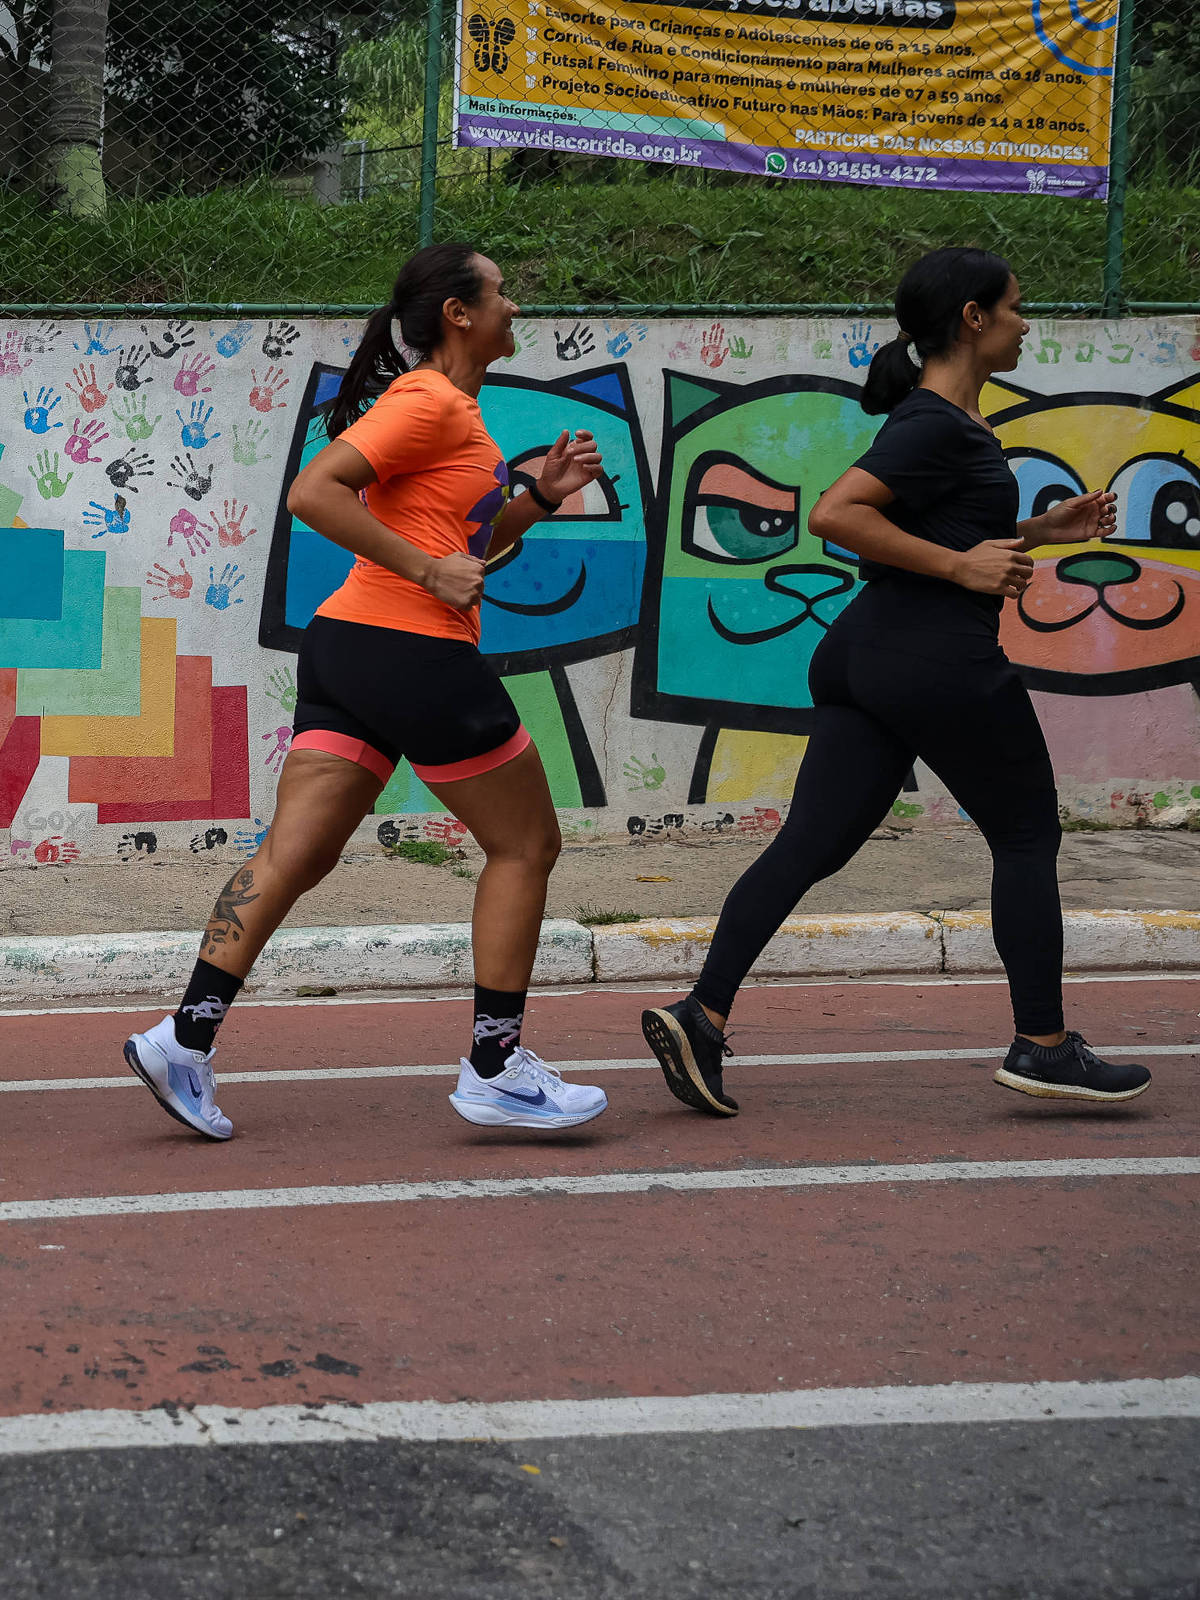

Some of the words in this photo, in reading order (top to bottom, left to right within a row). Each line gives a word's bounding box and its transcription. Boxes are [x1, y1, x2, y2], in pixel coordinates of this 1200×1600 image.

[545, 6, 605, 26] Esporte
[610, 17, 645, 31] para
[650, 19, 720, 38] Crianças
[724, 30, 734, 38] e
[738, 28, 846, 49] Adolescentes
[850, 38, 871, 50] de
[874, 39, 894, 51] 06
[898, 44, 909, 52] a
[912, 44, 931, 54] 15
[934, 44, 975, 56] anos.
[542, 52, 594, 70] Futsal
[598, 57, 669, 80] Feminino
[672, 70, 710, 84] para
[714, 72, 782, 90] meninas
[786, 80, 796, 90] e
[800, 80, 876, 98] mulheres
[880, 85, 900, 98] de
[906, 88, 924, 101] 07
[928, 91, 937, 100] a
[941, 91, 959, 104] 59
[964, 92, 1004, 104] anos.
[544, 28, 601, 47] Corrida
[606, 38, 628, 52] de
[631, 40, 663, 55] Rua
[666, 47, 676, 56] e
[681, 46, 823, 70] Condicionamento
[826, 60, 863, 74] para
[867, 61, 942, 78] Mulheres
[946, 67, 994, 80] acima
[1000, 68, 1021, 81] de
[1025, 70, 1042, 82] 18
[1045, 72, 1086, 85] anos.
[468, 100, 496, 113] Mais
[499, 104, 578, 121] informações:
[542, 75, 600, 95] Projeto
[604, 82, 729, 110] Socioeducativo
[733, 97, 786, 114] Futuro
[790, 104, 818, 117] nas
[822, 103, 869, 120] Mãos:
[873, 107, 907, 122] Para
[910, 111, 964, 126] jovens
[967, 114, 986, 127] de
[990, 117, 1009, 130] 14
[1013, 119, 1024, 129] a
[1027, 118, 1044, 130] 18
[1048, 120, 1090, 133] anos.
[468, 125, 702, 164] www.vidacorrida.org.br
[795, 129, 880, 148] PARTICIPE
[883, 135, 915, 150] DAS
[918, 137, 985, 155] NOSSAS
[988, 141, 1089, 161] ATIVIDADES!
[792, 158, 824, 175] (11)
[827, 161, 938, 182] 91551-4272
